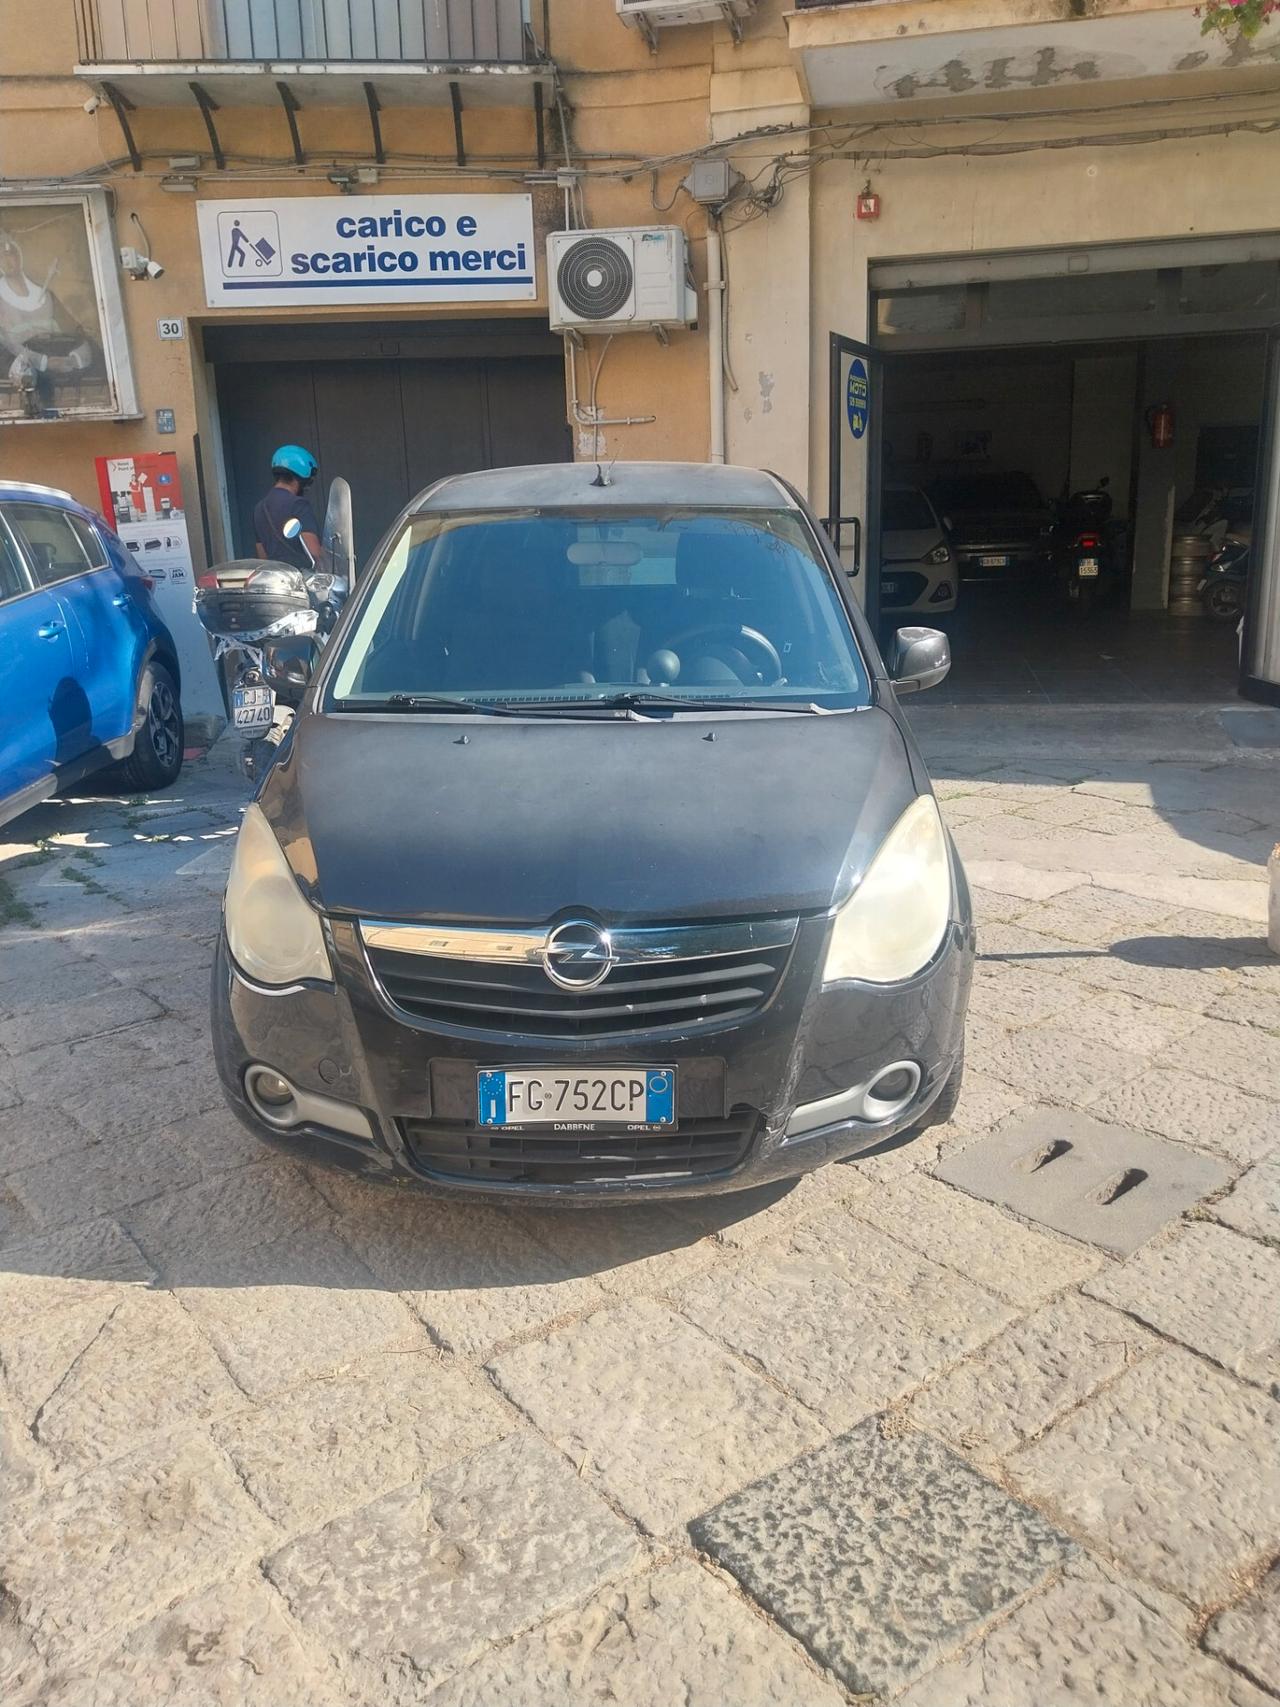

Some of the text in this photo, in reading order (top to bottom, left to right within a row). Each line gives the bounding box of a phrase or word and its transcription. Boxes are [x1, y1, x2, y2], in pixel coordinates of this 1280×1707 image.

[336, 209, 478, 239] carico e
[290, 243, 526, 275] scarico merci
[162, 322, 179, 335] 30
[236, 707, 270, 724] 42740
